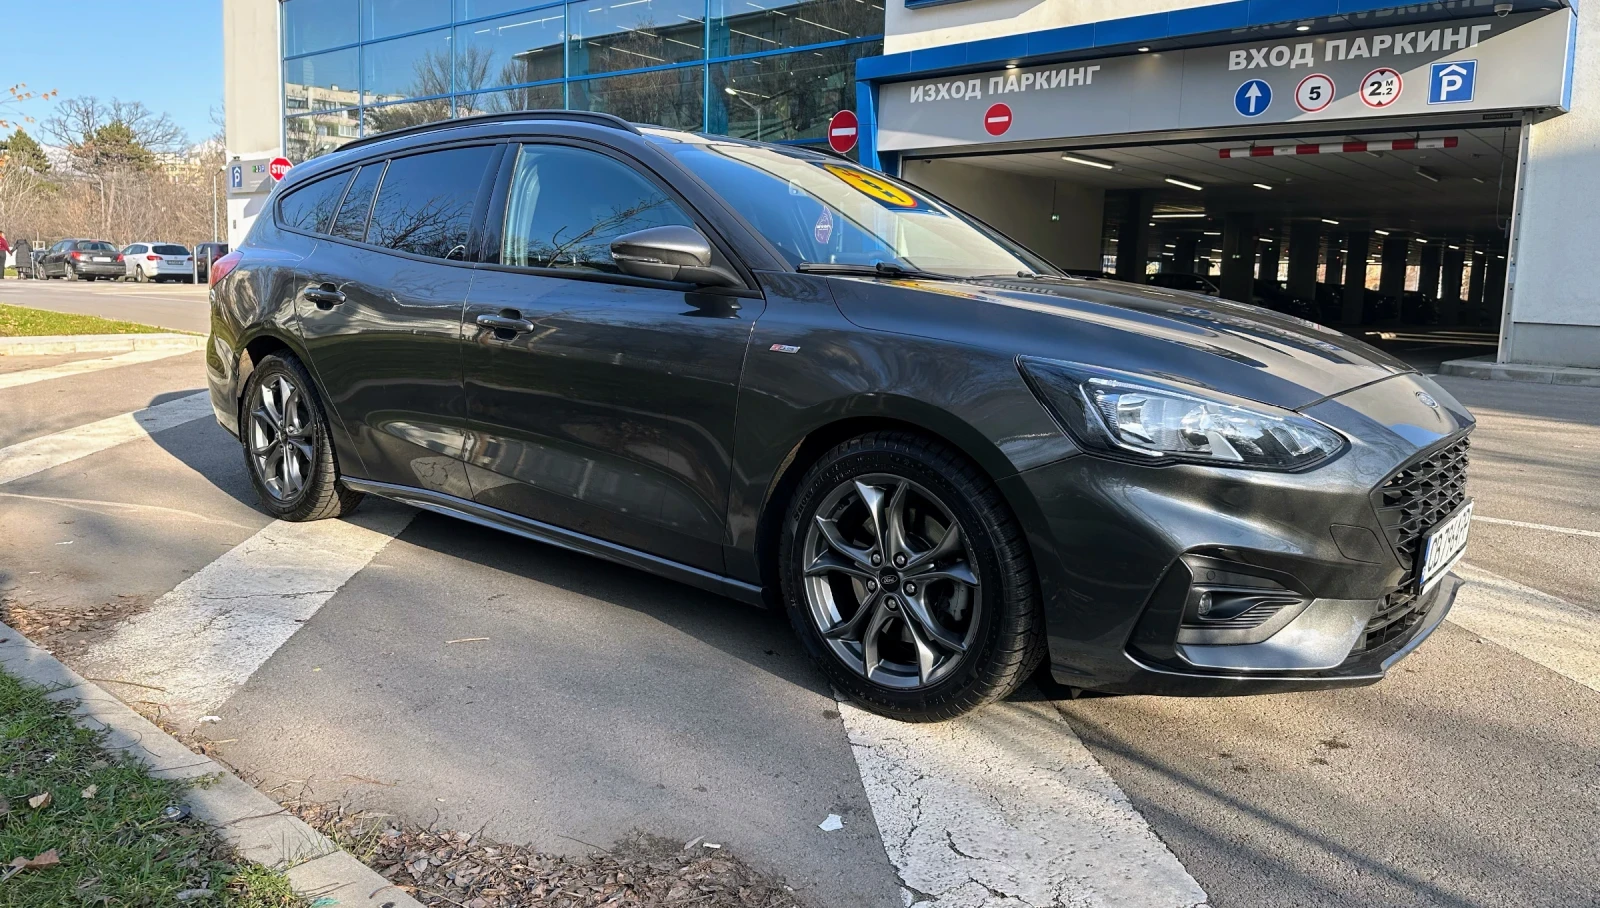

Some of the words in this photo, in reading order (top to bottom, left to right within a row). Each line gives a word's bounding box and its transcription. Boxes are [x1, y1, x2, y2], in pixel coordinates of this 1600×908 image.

[1228, 42, 1314, 71] ВХОД
[1324, 24, 1492, 62] ПАРКИНГ
[910, 78, 982, 103] ИЗХОД
[988, 65, 1101, 95] ПАРКИНГ
[1308, 86, 1322, 101] 5
[1440, 75, 1462, 101] P
[271, 164, 291, 175] STOP
